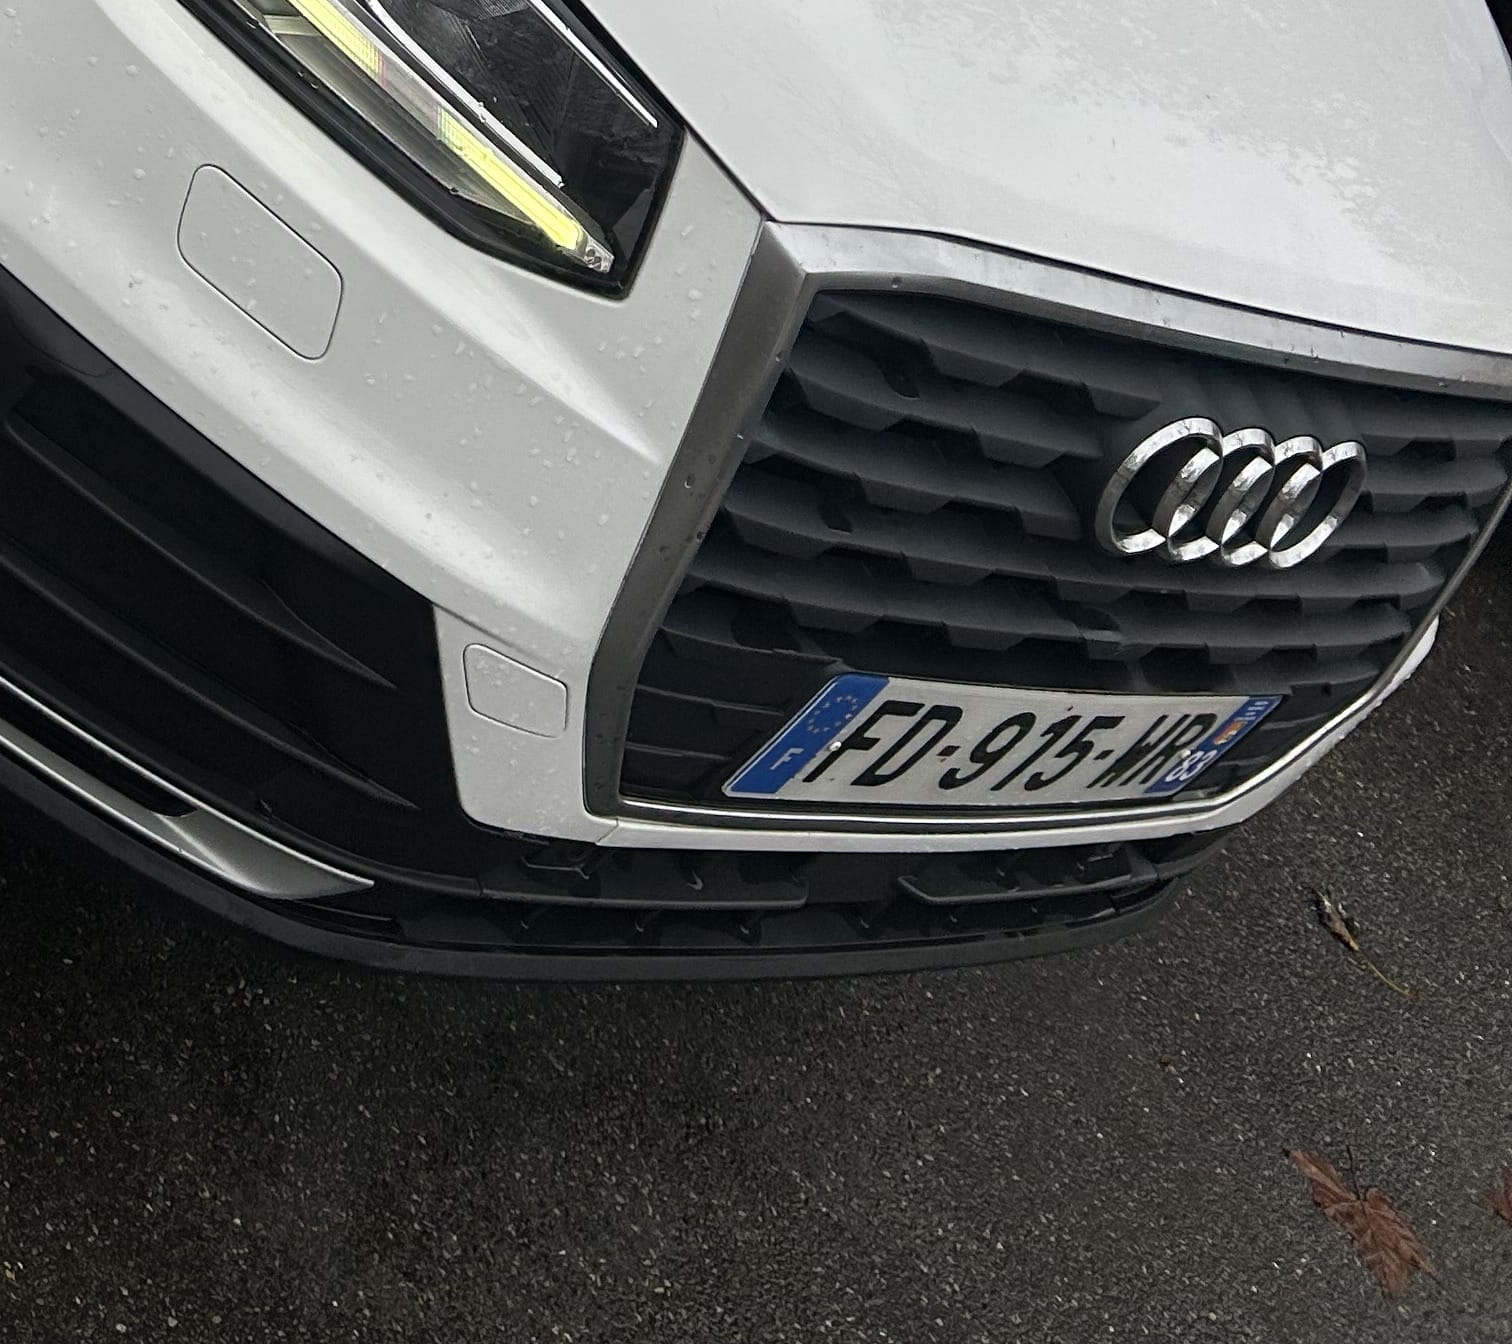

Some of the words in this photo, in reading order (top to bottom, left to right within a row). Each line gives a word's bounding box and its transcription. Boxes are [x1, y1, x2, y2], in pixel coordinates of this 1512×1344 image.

[770, 747, 804, 770] F
[802, 699, 1219, 792] FD-915-WR
[1165, 749, 1213, 782] 83
